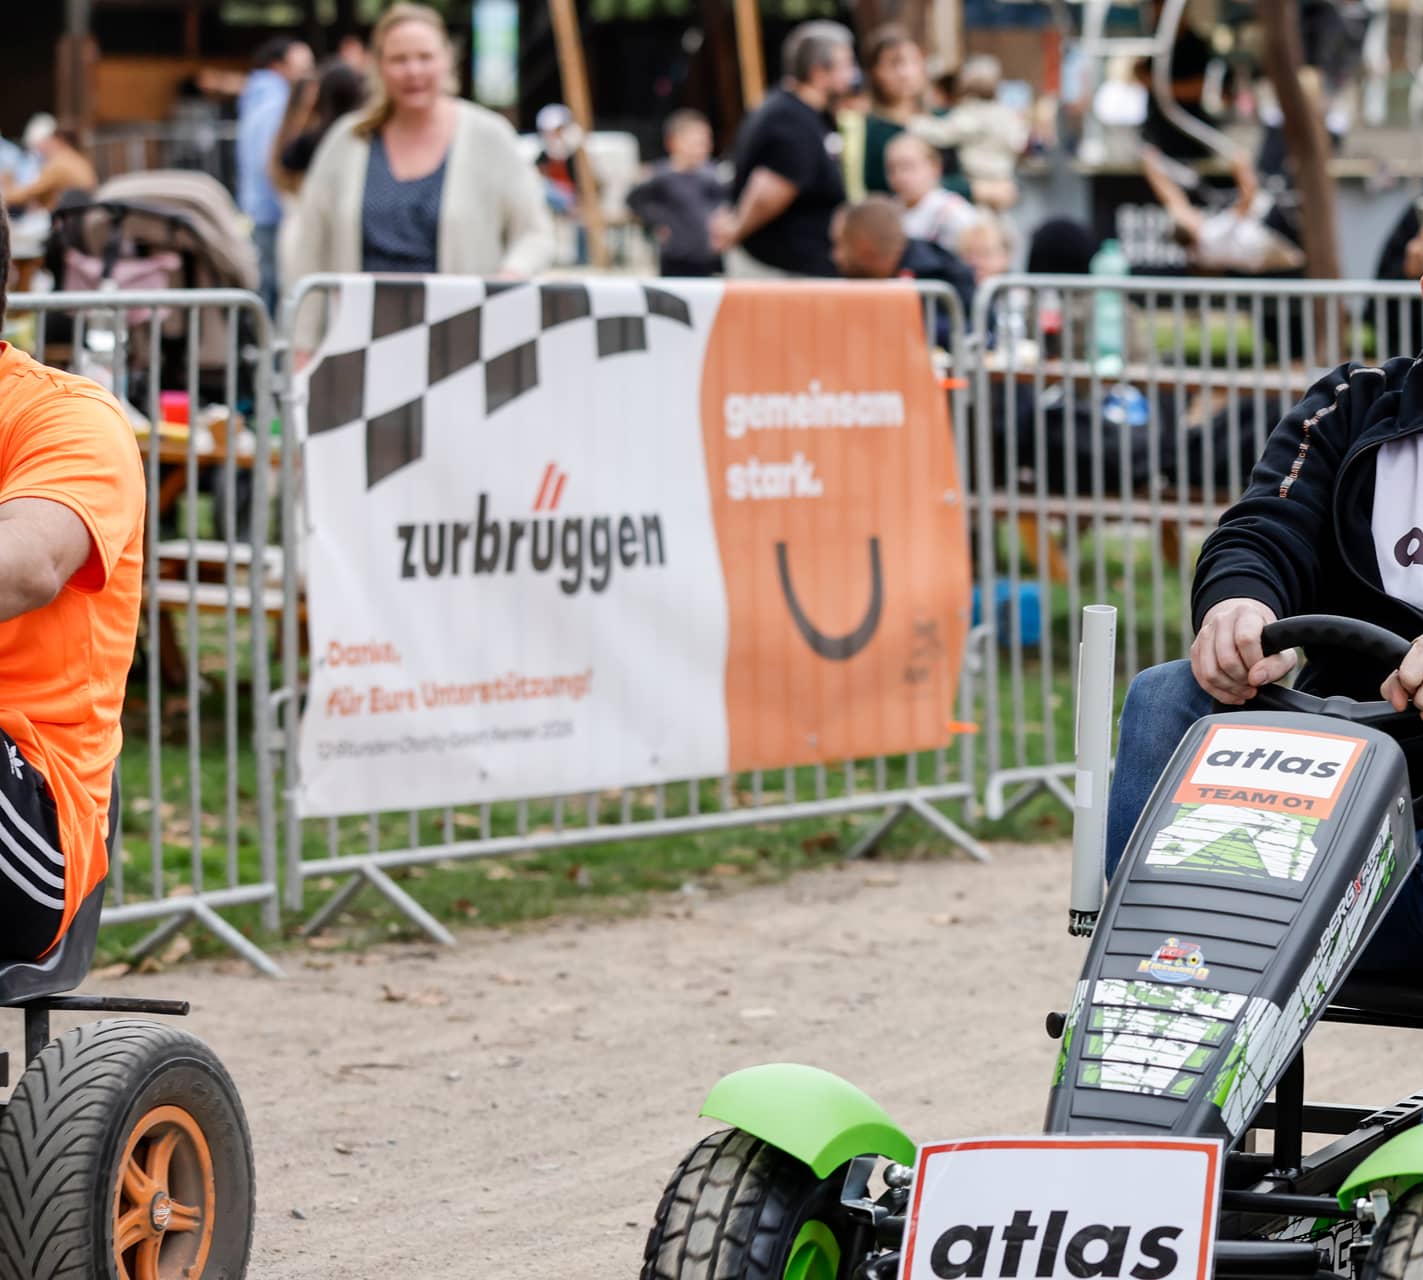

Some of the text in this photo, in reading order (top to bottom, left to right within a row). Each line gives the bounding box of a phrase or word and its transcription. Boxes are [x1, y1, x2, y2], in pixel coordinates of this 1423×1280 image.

[724, 379, 905, 438] gemeinsam
[397, 461, 667, 595] zurbrüggen
[1206, 747, 1342, 779] atlas
[1197, 787, 1277, 805] TEAM
[930, 1209, 1185, 1280] atlas
